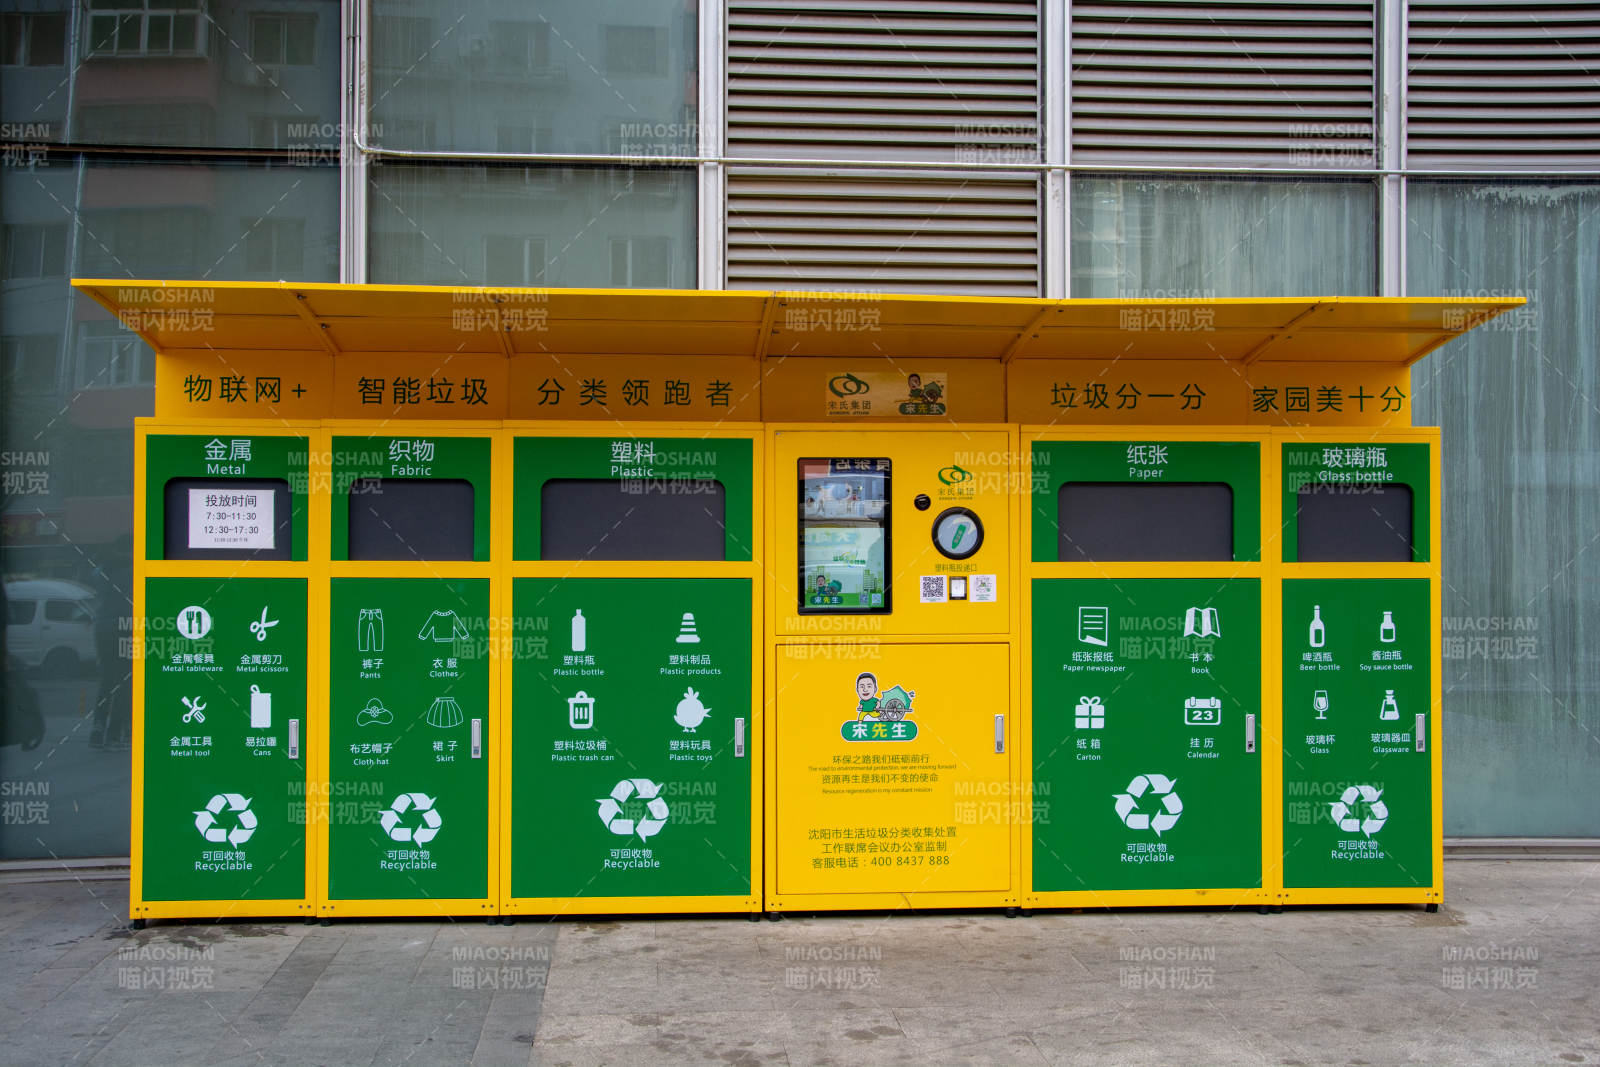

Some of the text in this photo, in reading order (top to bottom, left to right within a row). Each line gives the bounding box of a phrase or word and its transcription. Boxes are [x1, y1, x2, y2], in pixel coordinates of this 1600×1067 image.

[184, 375, 280, 403] 物联网
[358, 377, 488, 405] 智能垃圾
[538, 379, 732, 406] 分类领跑者
[1051, 383, 1206, 410] 垃圾分一分
[1252, 385, 1407, 413] 家园美十分
[205, 439, 251, 461] 金属
[389, 440, 434, 461] 织物
[611, 442, 656, 464] 塑料
[1127, 445, 1168, 464] 纸张
[1323, 447, 1387, 468] 玻璃瓶
[208, 464, 244, 474] Metal
[392, 464, 431, 475] Fabric
[612, 466, 653, 476] Plastic
[1130, 468, 1163, 480] Paper
[1319, 471, 1392, 483] Glass bottle
[205, 495, 256, 507] 投放时间
[207, 512, 256, 520] 7:30-11:30
[205, 526, 258, 534] 12:30-17:30
[172, 654, 214, 663] 金属餐具
[241, 655, 281, 664] 金属剪刀
[564, 655, 594, 665] 塑料瓶
[670, 655, 710, 664] 塑料制品
[1072, 652, 1113, 662] 纸张报纸
[1189, 652, 1212, 662] 书本
[1303, 652, 1332, 661] 啤酒瓶
[1373, 650, 1401, 660] 酱油瓶
[363, 659, 383, 669] 裤子
[433, 658, 457, 668] 衣服
[1064, 664, 1084, 672] Paper
[688, 668, 721, 676] products
[1192, 710, 1214, 721] 23
[852, 724, 907, 738] 宋先生
[170, 736, 212, 746] 金属工具
[246, 737, 276, 746] 易拉罐
[1306, 735, 1335, 744] 玻璃杯
[1371, 733, 1410, 742] 玻璃器皿
[350, 743, 392, 753] 布艺帽子
[433, 741, 457, 751] 裙子
[554, 740, 606, 750] 塑料垃圾桶
[670, 740, 711, 750] 塑料玩具
[1077, 739, 1100, 749] 纸箱
[1190, 738, 1213, 748] 挂历
[354, 759, 374, 767] Cloth
[823, 773, 938, 784] 资源再生是我们不变的使命
[809, 827, 956, 840] 沈阳市生活垃圾分类收集处置
[822, 841, 946, 854] 工作联席会议办公室监制
[1127, 843, 1167, 853] 可回收物
[1337, 840, 1377, 850] 可回收物
[202, 851, 246, 861] 可回收物
[387, 850, 430, 860] 可回收物
[610, 849, 652, 859] 可回收物
[1121, 853, 1174, 863] Recyclable
[1331, 850, 1385, 860] Recyclable
[195, 860, 252, 871] Recyclable
[381, 859, 436, 870] Recyclable
[604, 859, 660, 870] Recyclable
[896, 856, 924, 866] 8437
[928, 856, 950, 865] 888
